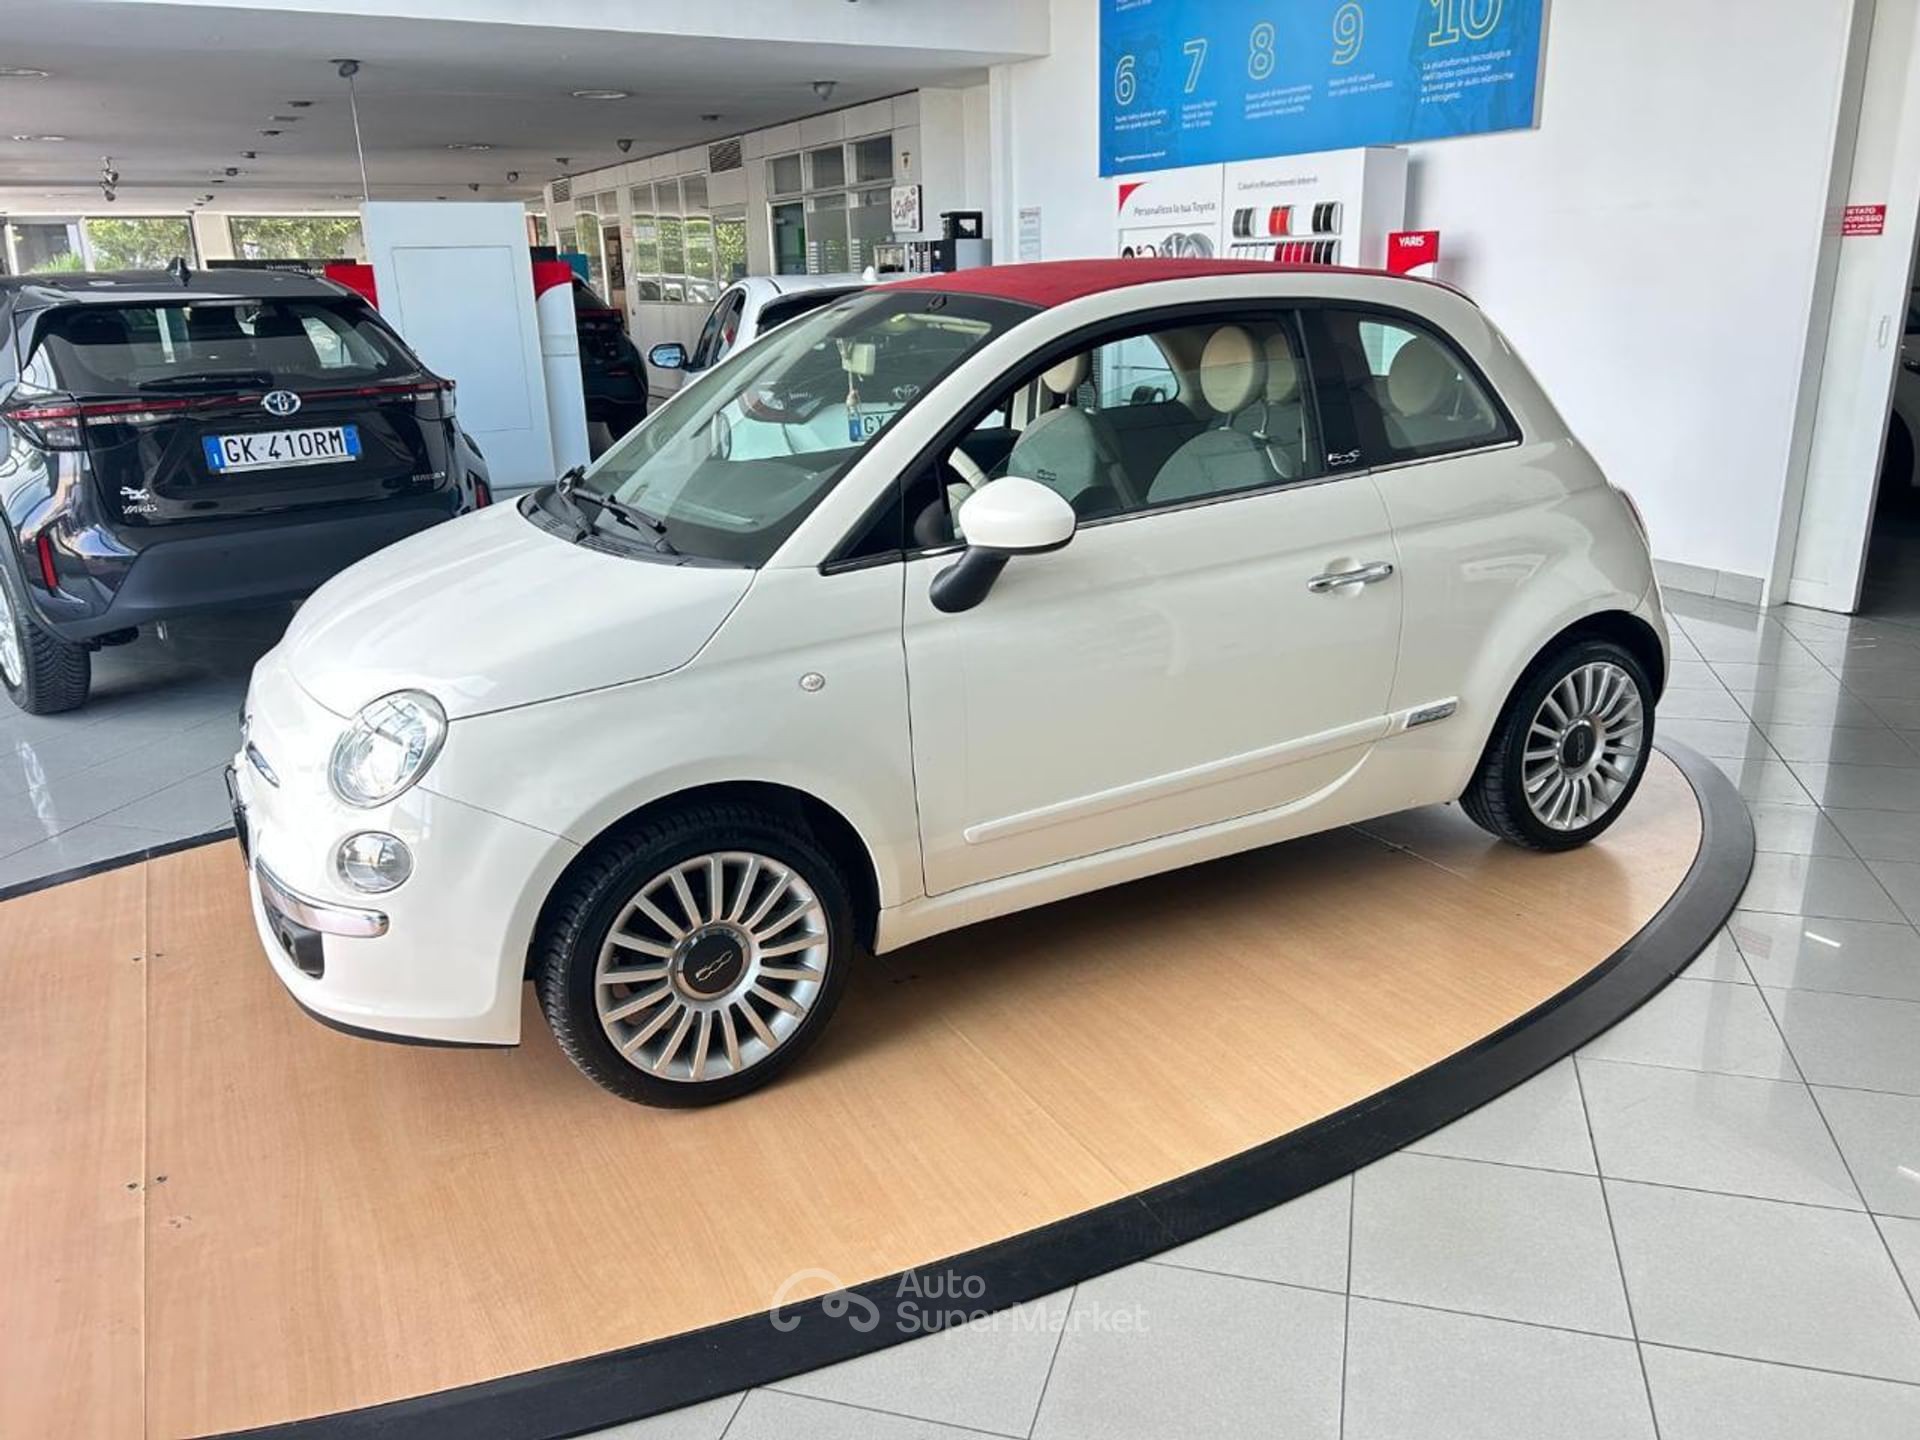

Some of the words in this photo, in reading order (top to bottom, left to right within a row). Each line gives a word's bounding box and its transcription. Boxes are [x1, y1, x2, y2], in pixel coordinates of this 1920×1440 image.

[1332, 2, 1364, 65] 9
[1428, 0, 1502, 47] 10
[1183, 38, 1208, 94] 7
[1248, 22, 1275, 80] 8
[1114, 54, 1136, 106] 6
[1399, 235, 1425, 247] YARIS
[224, 437, 257, 463] GK
[268, 429, 345, 460] 410RM
